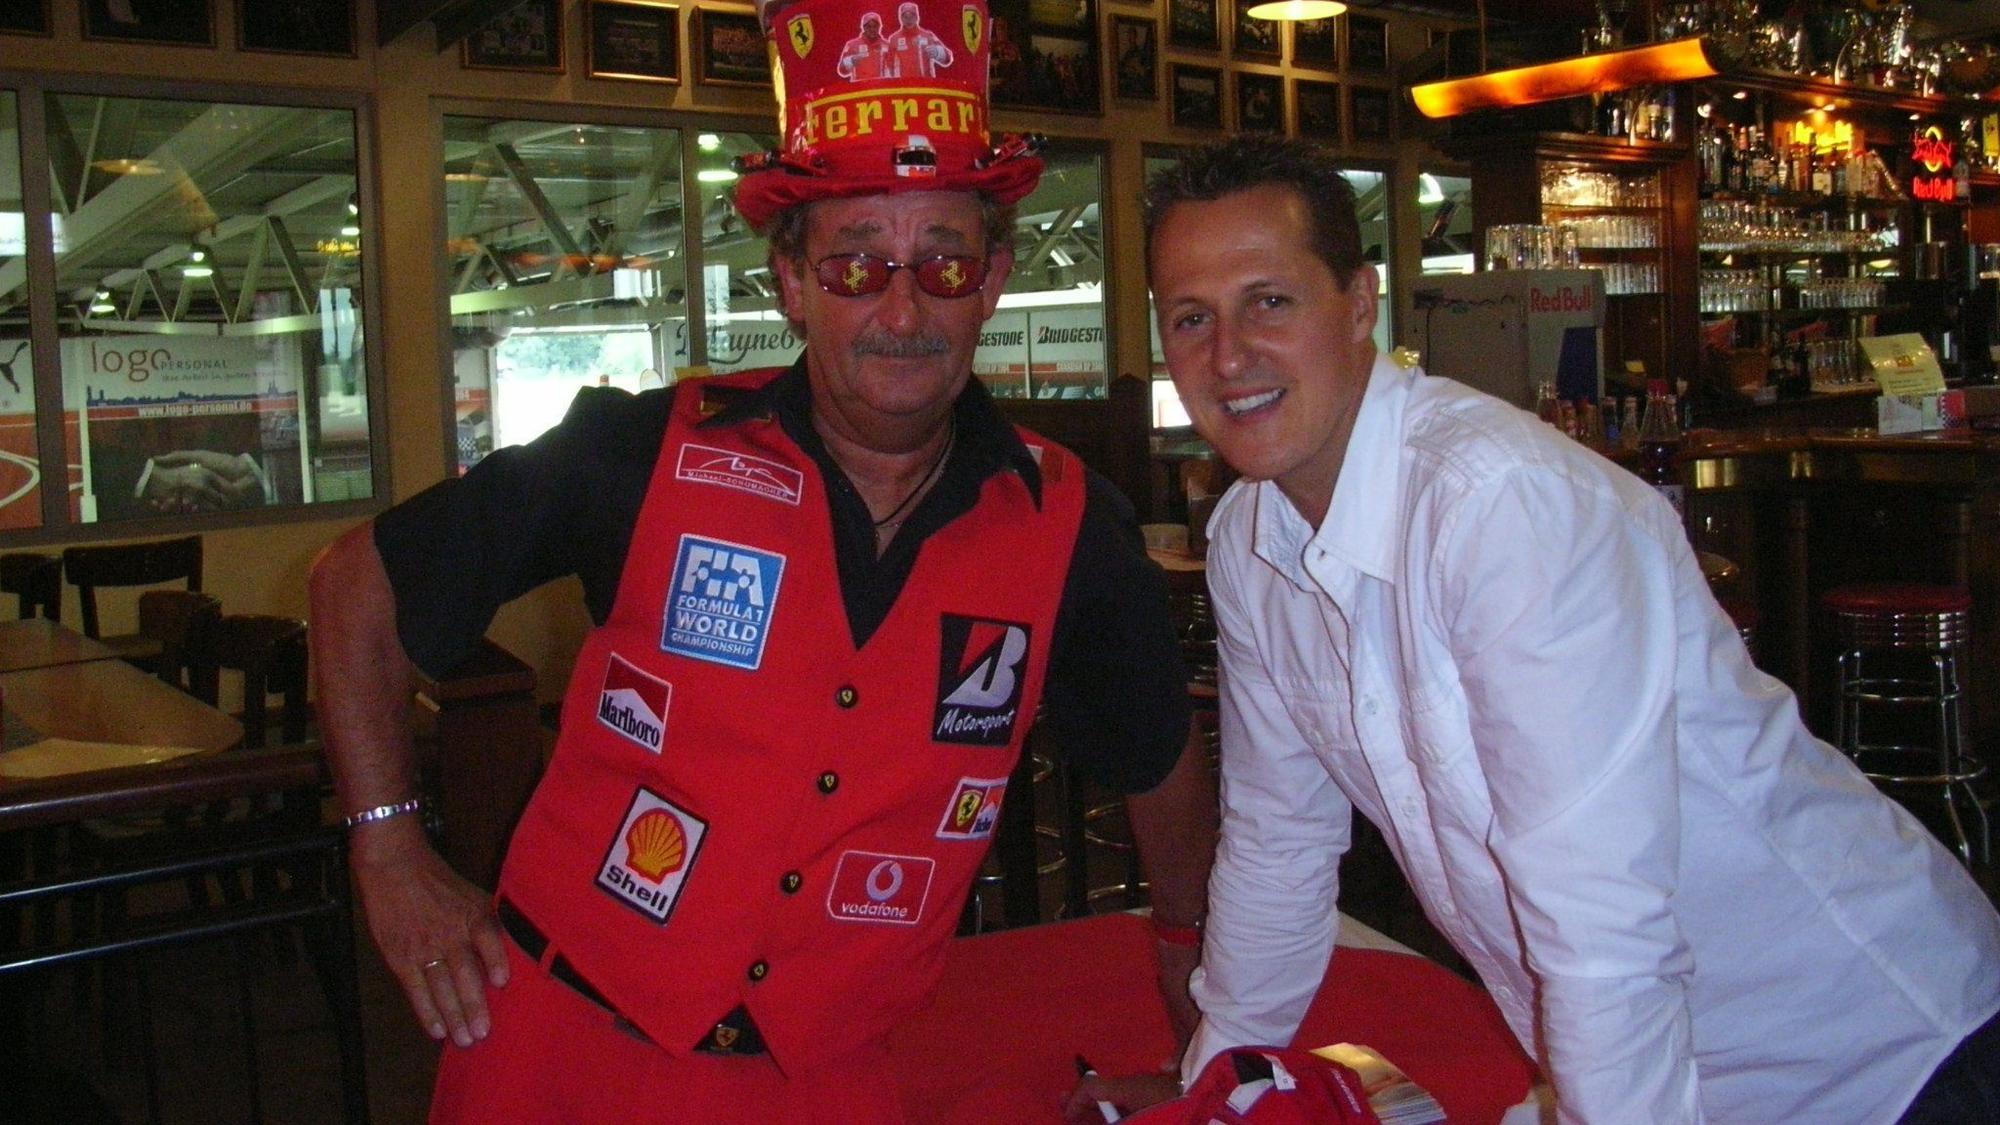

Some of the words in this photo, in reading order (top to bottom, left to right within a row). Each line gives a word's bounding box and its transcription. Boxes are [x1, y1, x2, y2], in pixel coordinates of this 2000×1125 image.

[91, 341, 171, 382] logo
[160, 360, 228, 371] PERSONAL
[681, 546, 764, 606] FIA
[677, 595, 753, 619] FORMULA
[675, 611, 757, 642] WORLD
[671, 632, 754, 656] CHAMPIONSHIP
[600, 692, 660, 747] Marlboro
[937, 708, 1014, 737] Motorsport
[606, 864, 668, 912] Shell
[842, 902, 908, 918] vodafone
